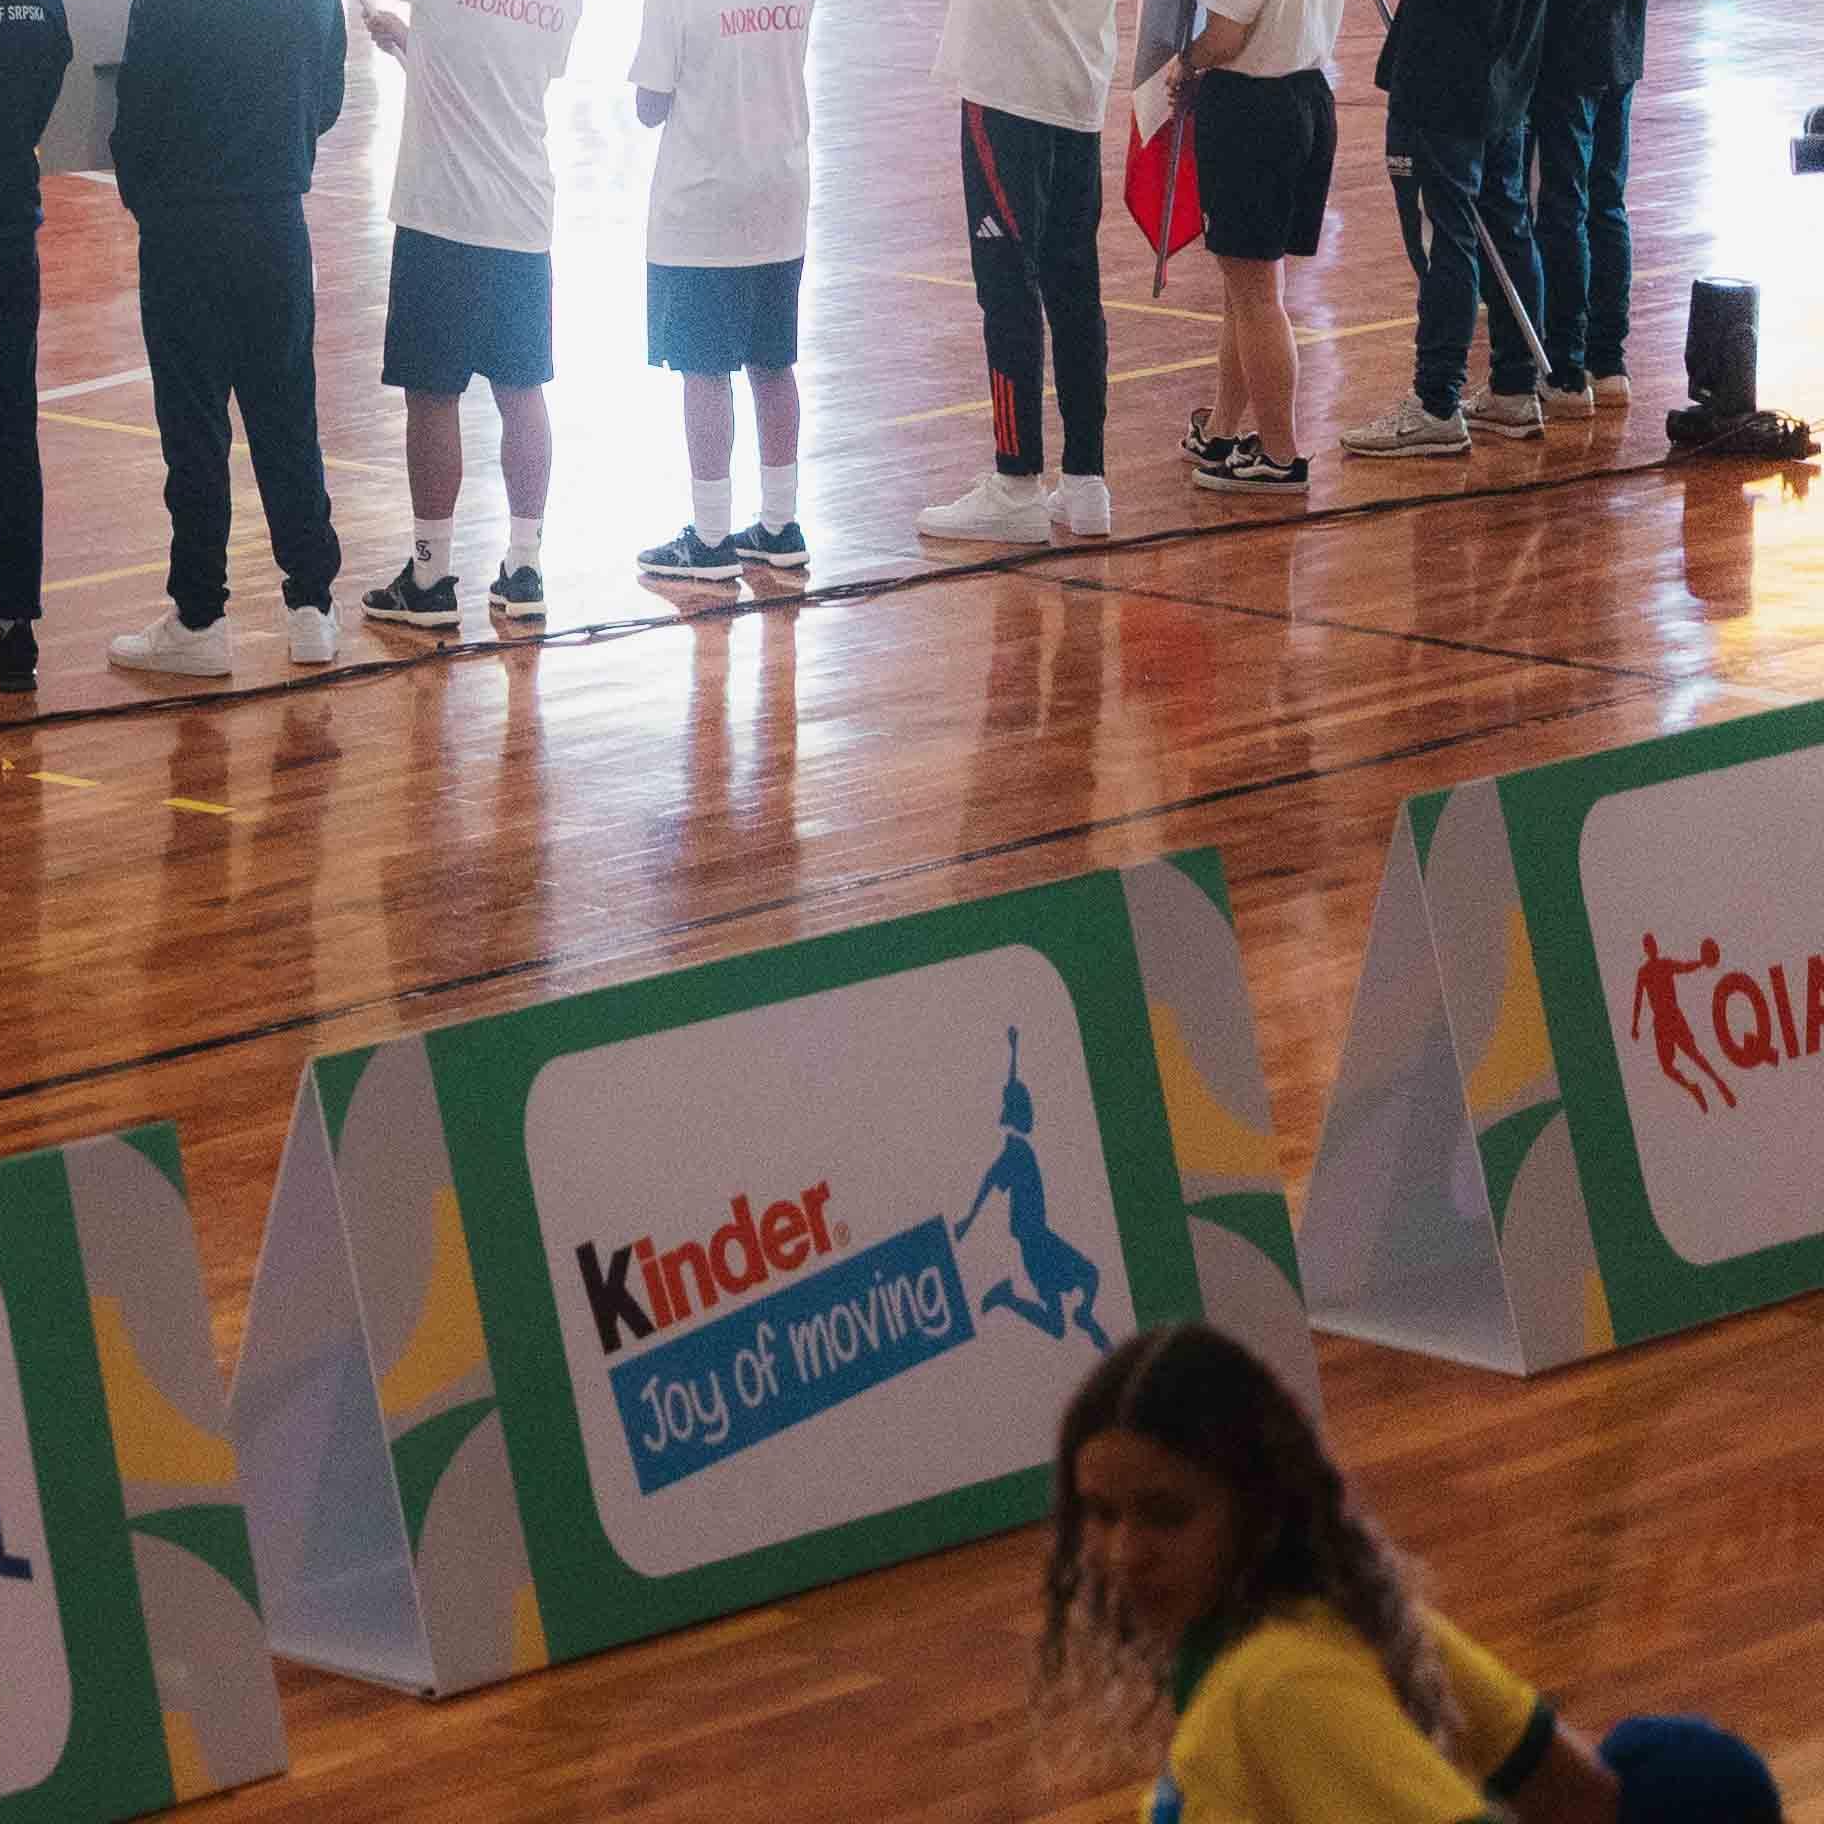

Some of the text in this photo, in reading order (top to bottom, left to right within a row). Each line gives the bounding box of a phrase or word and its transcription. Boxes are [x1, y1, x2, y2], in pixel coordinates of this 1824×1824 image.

[7, 5, 46, 23] SRPSKA
[575, 1180, 833, 1356] Kinder
[640, 1265, 953, 1452] Joy of moving
